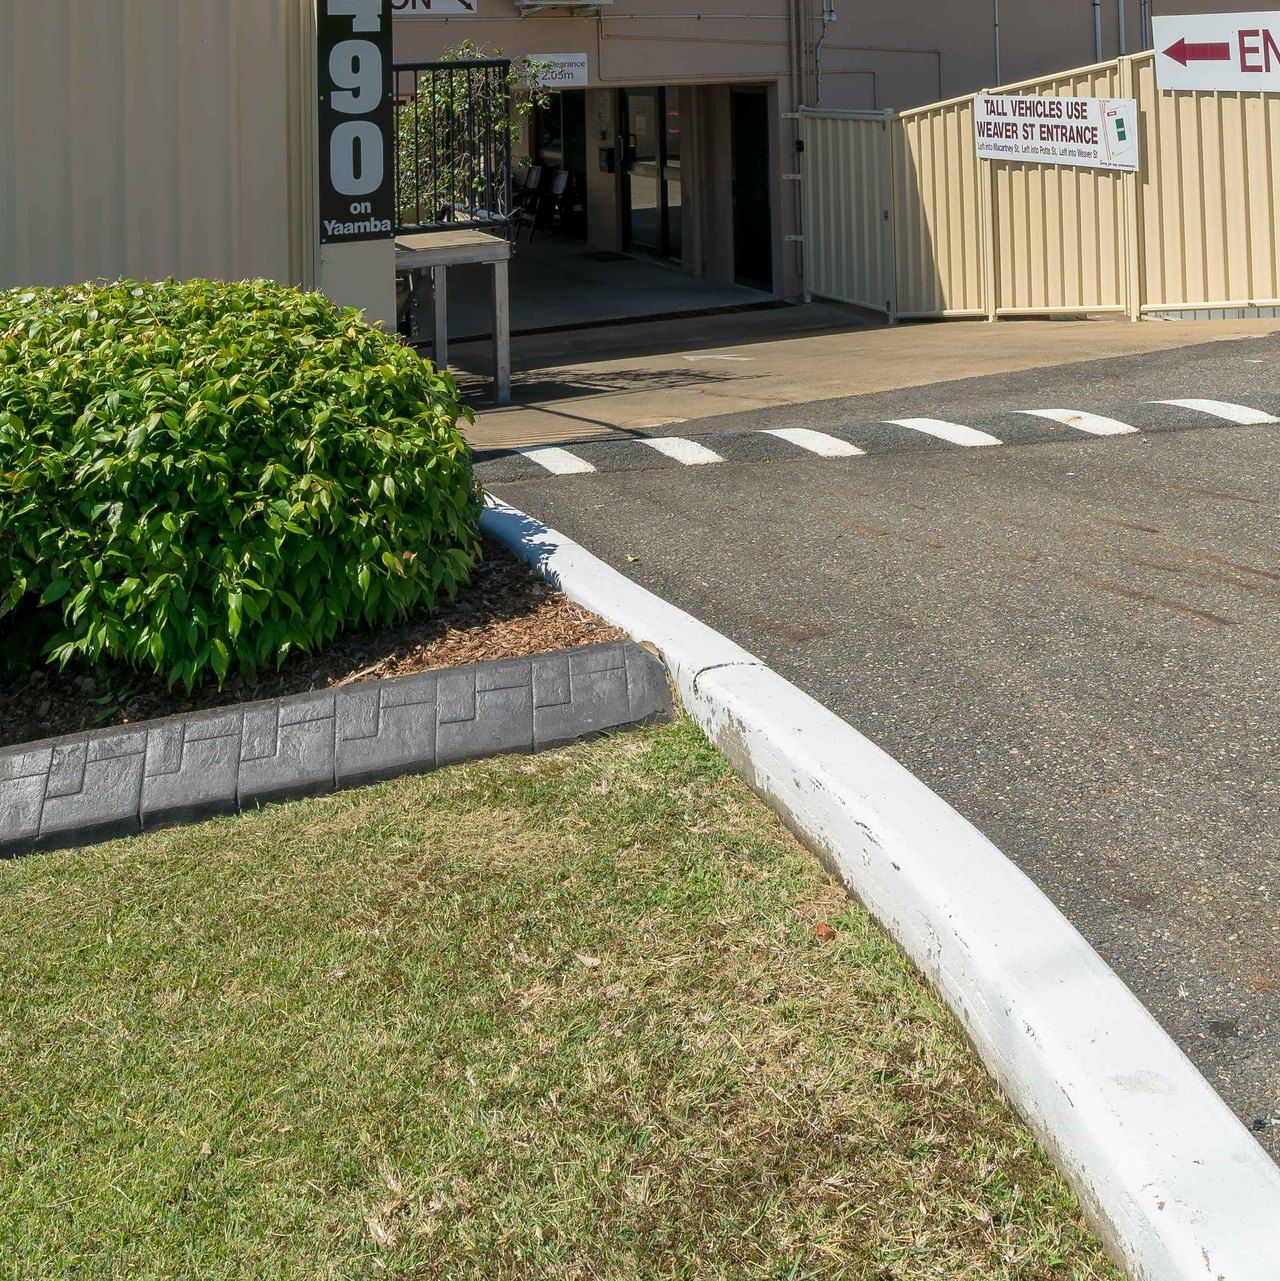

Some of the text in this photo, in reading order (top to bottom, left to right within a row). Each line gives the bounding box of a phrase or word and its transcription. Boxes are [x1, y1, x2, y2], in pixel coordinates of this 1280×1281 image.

[541, 71, 574, 81] 2.05m
[984, 100, 1088, 120] TALL VEHICLES USE
[977, 121, 1098, 145] WEAVER ST ENTRANCE
[1031, 146, 1039, 154] into
[1059, 148, 1067, 156] Left
[1068, 148, 1076, 157] into
[350, 202, 371, 214] on
[323, 218, 391, 236] Yaamba
